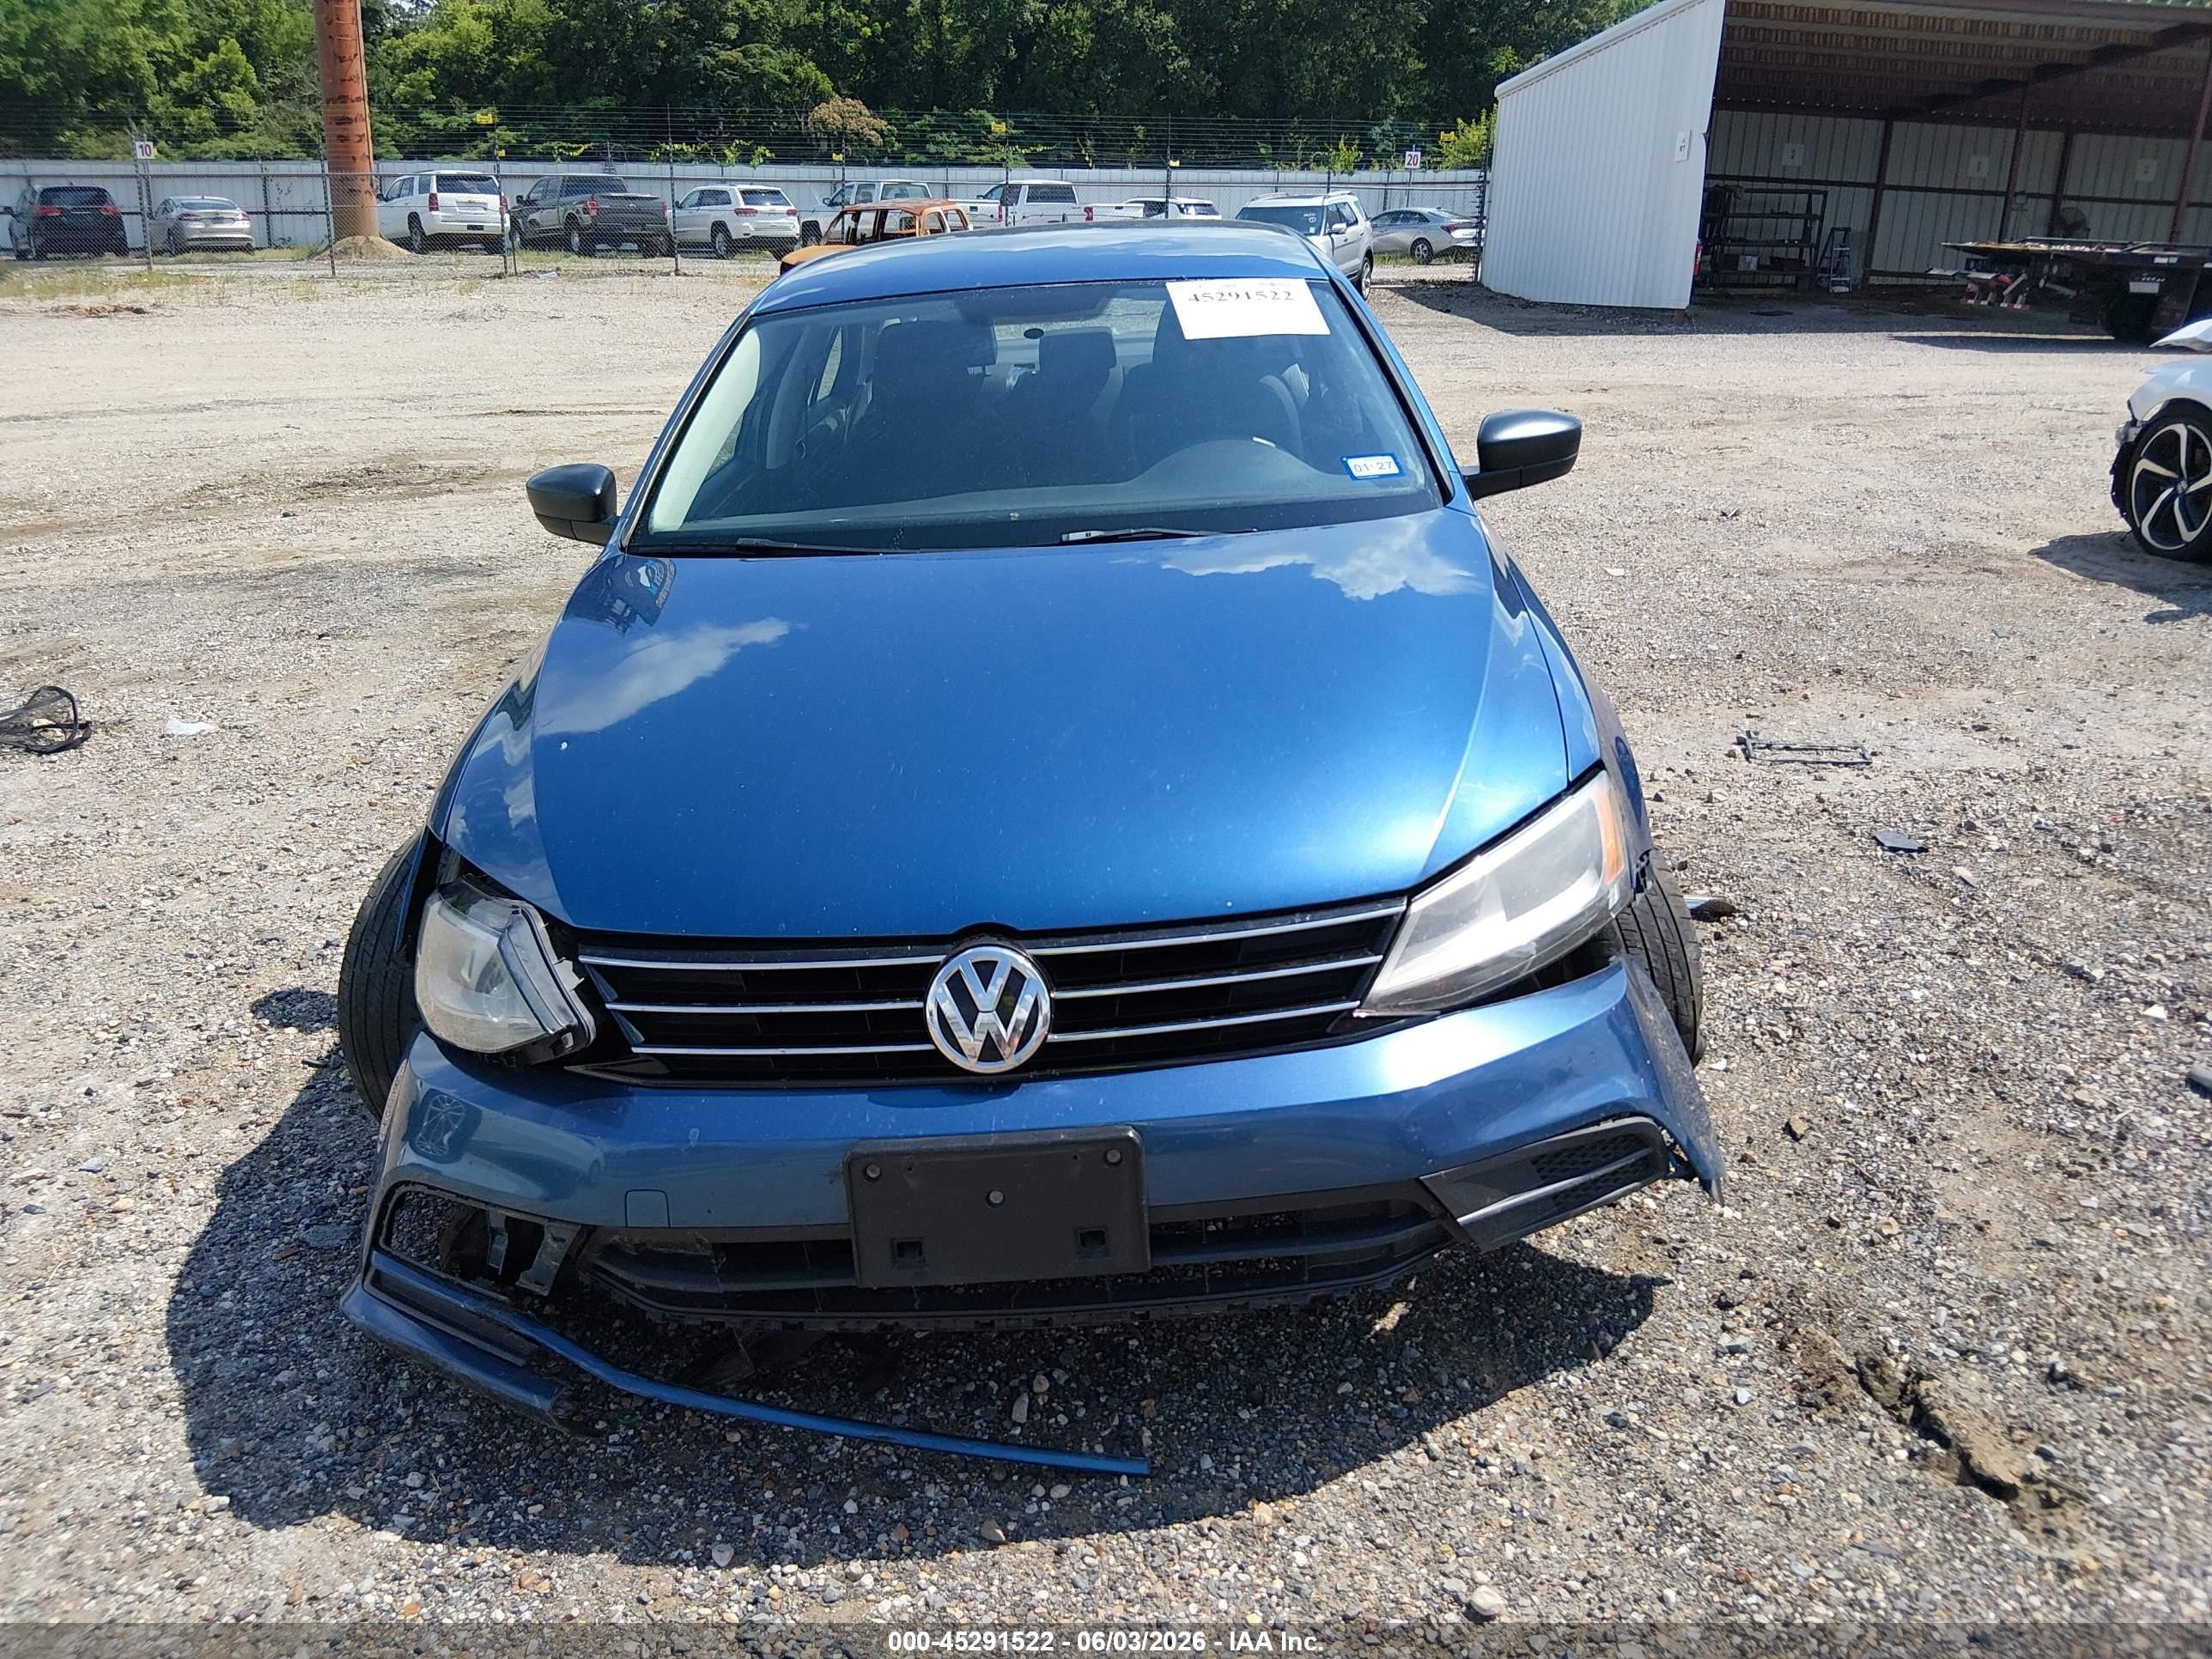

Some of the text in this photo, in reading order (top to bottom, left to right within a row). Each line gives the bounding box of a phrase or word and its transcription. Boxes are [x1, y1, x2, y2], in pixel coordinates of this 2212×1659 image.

[138, 143, 152, 157] 10
[1407, 154, 1419, 167] 20
[1188, 290, 1295, 303] 45291522
[928, 948, 1048, 1072] VW
